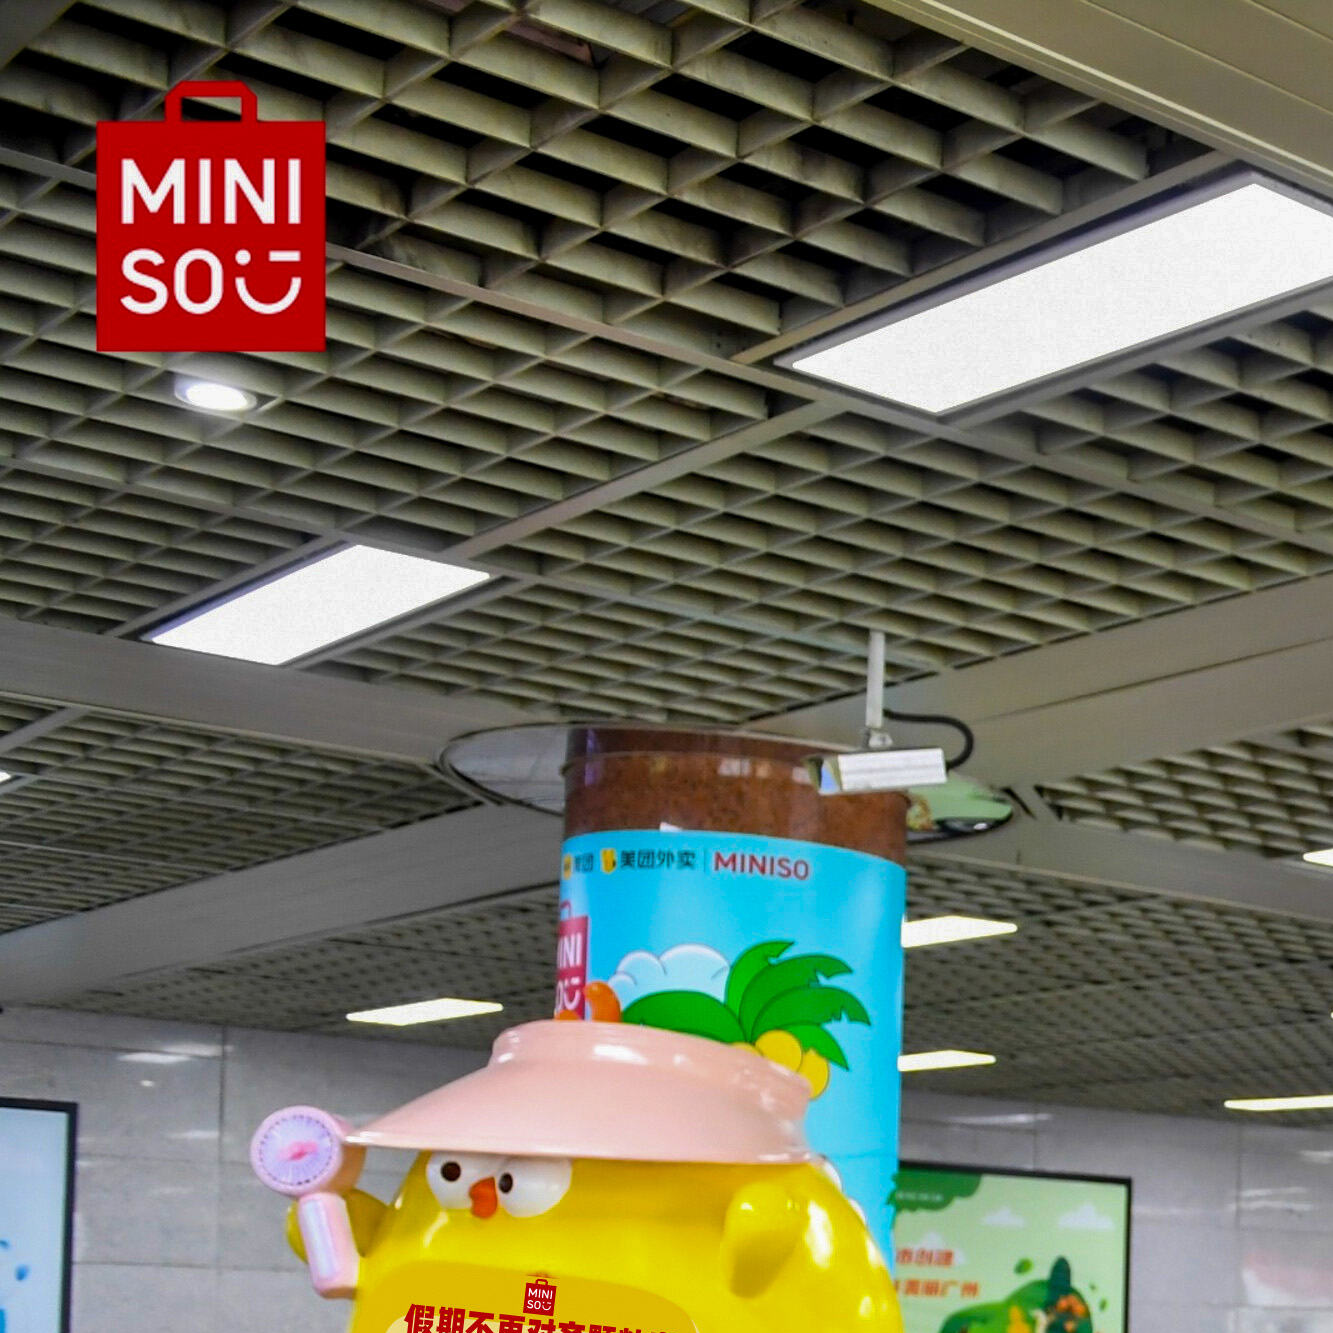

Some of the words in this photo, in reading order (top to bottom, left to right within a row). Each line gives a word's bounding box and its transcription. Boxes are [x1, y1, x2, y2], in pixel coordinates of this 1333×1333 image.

[619, 849, 697, 871] 美团外卖
[713, 851, 810, 881] MINISO
[527, 1287, 554, 1300] MINI
